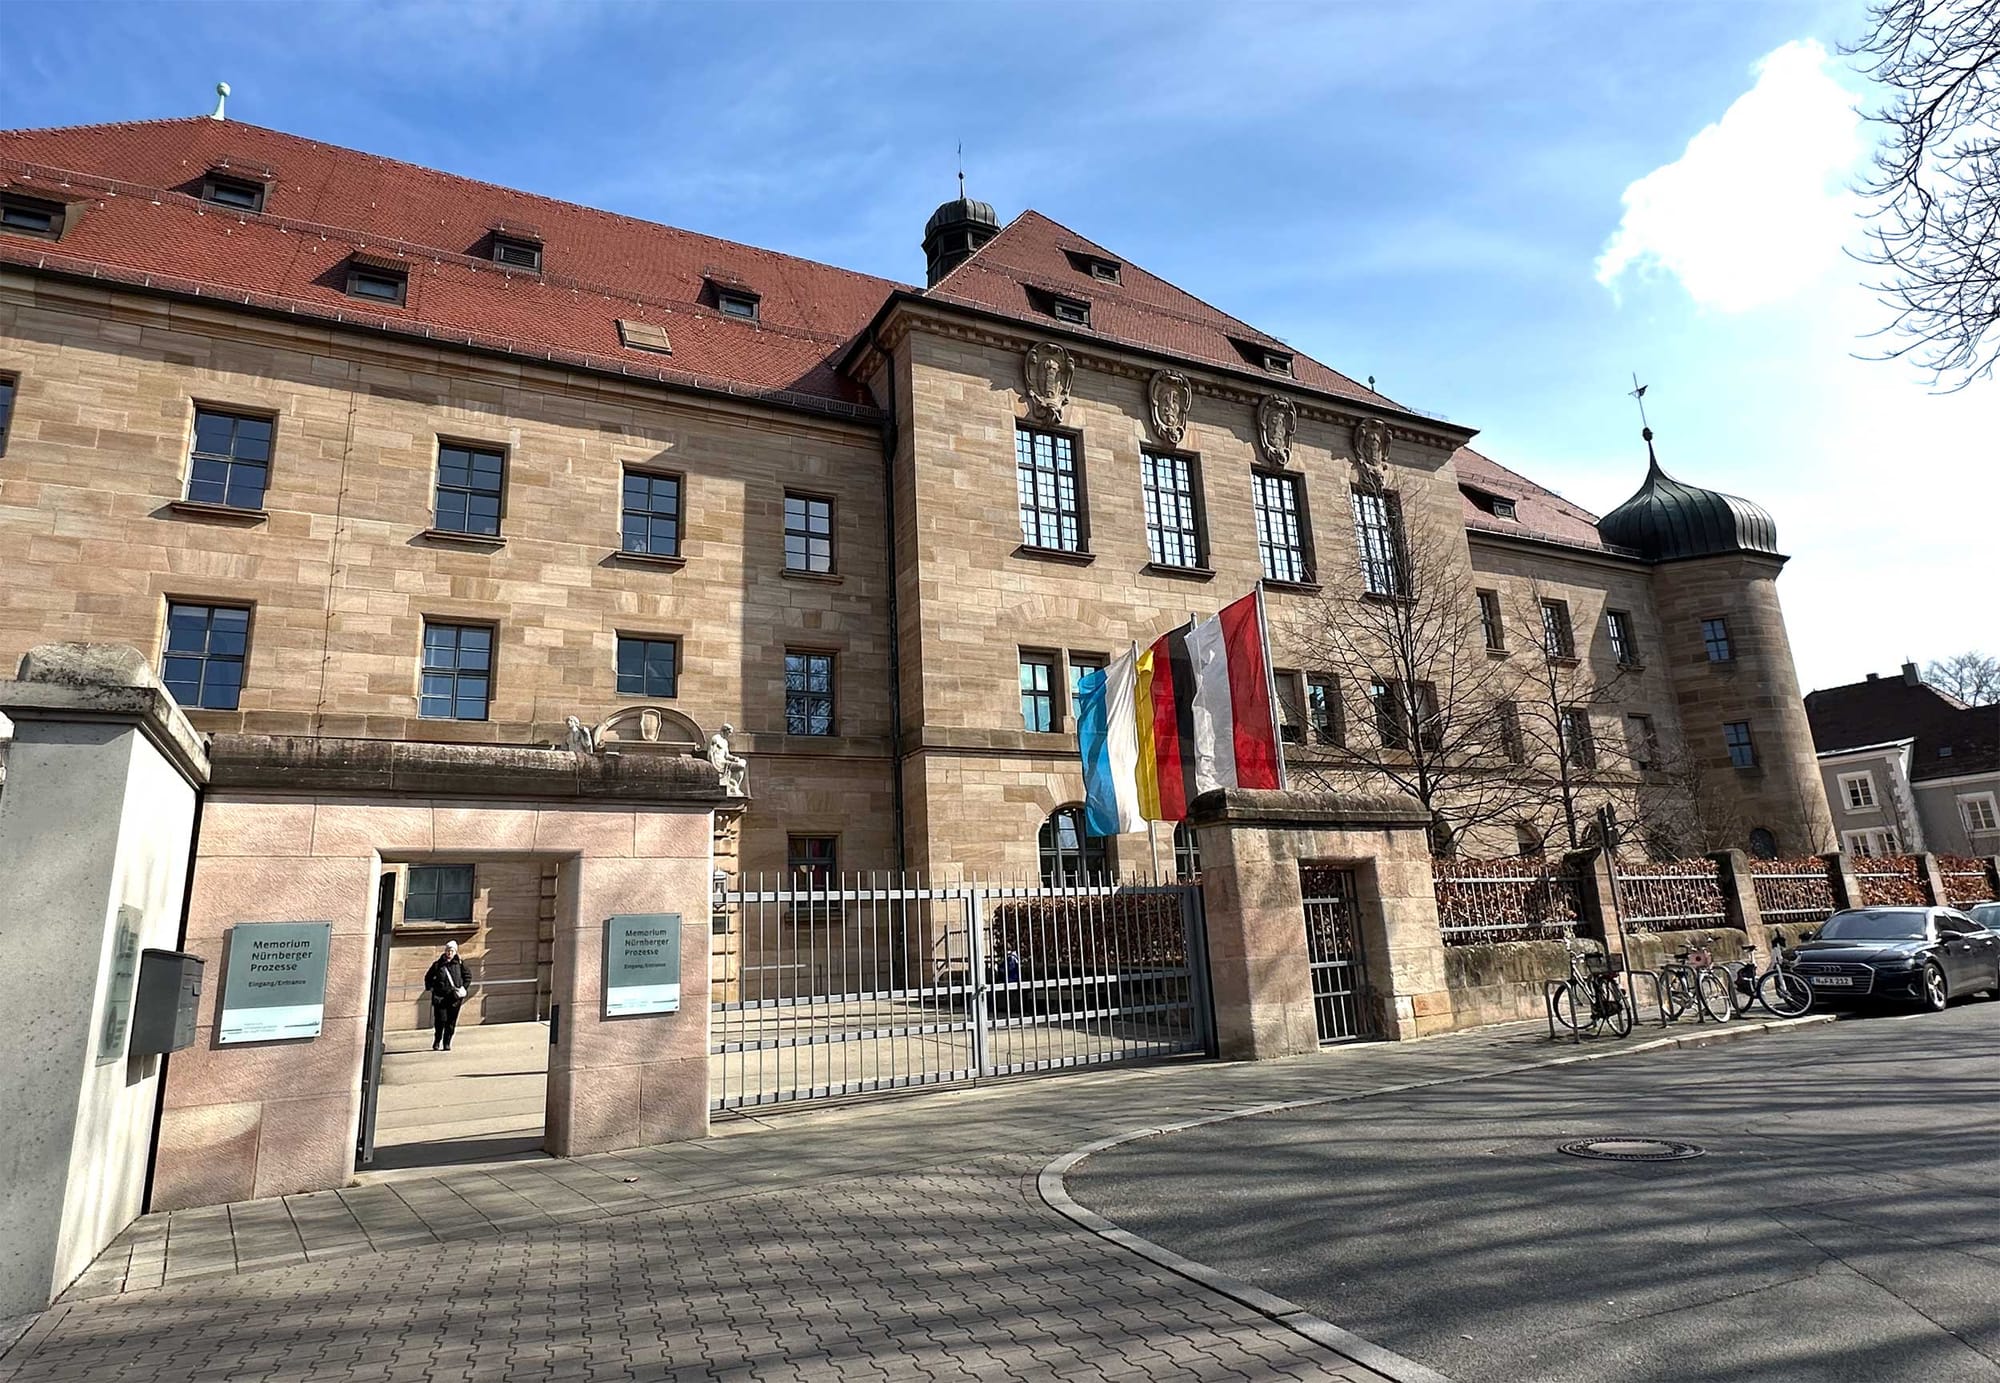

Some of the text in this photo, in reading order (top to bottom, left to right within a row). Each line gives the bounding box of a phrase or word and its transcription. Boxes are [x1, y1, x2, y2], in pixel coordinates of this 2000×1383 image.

[625, 929, 667, 937] Memorium
[253, 940, 310, 949] Memorium
[624, 939, 669, 947] Nürnberger
[251, 951, 313, 961] Nürnberger
[250, 963, 298, 972] Prozesse
